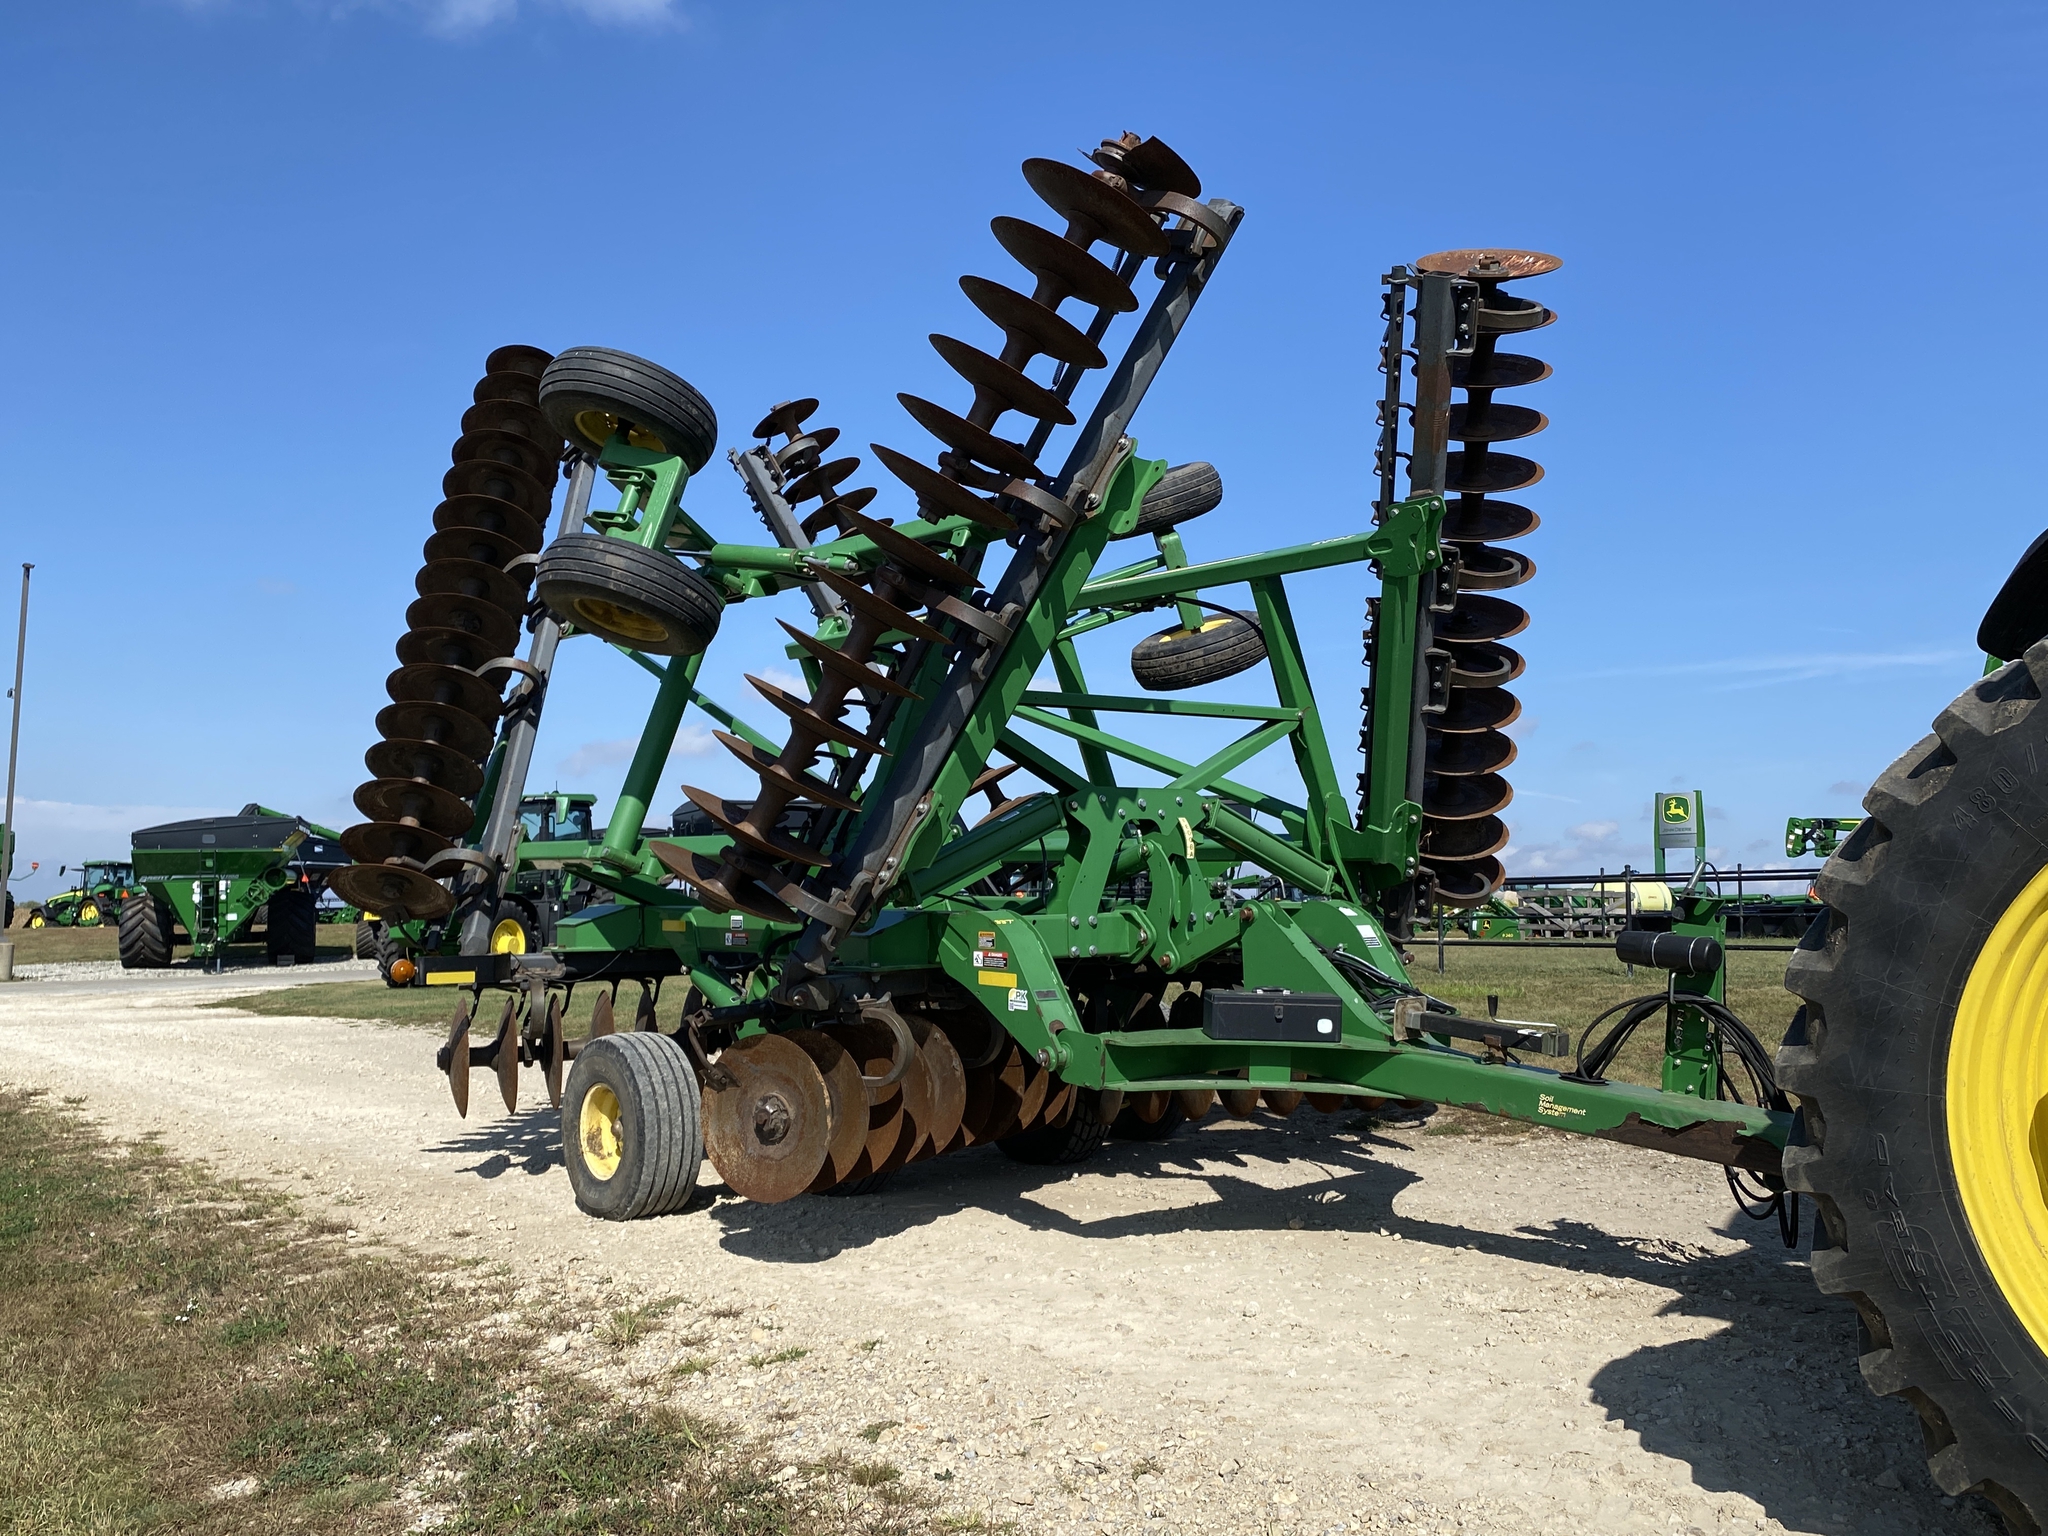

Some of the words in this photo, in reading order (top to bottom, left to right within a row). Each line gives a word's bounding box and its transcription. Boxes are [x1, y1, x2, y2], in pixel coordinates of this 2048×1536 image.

[1952, 734, 2048, 831] 480/
[1539, 1094, 1554, 1102] Soil
[1537, 1107, 1566, 1117] System
[1538, 1101, 1586, 1115] Management
[1955, 1261, 1990, 1320] RADIAL
